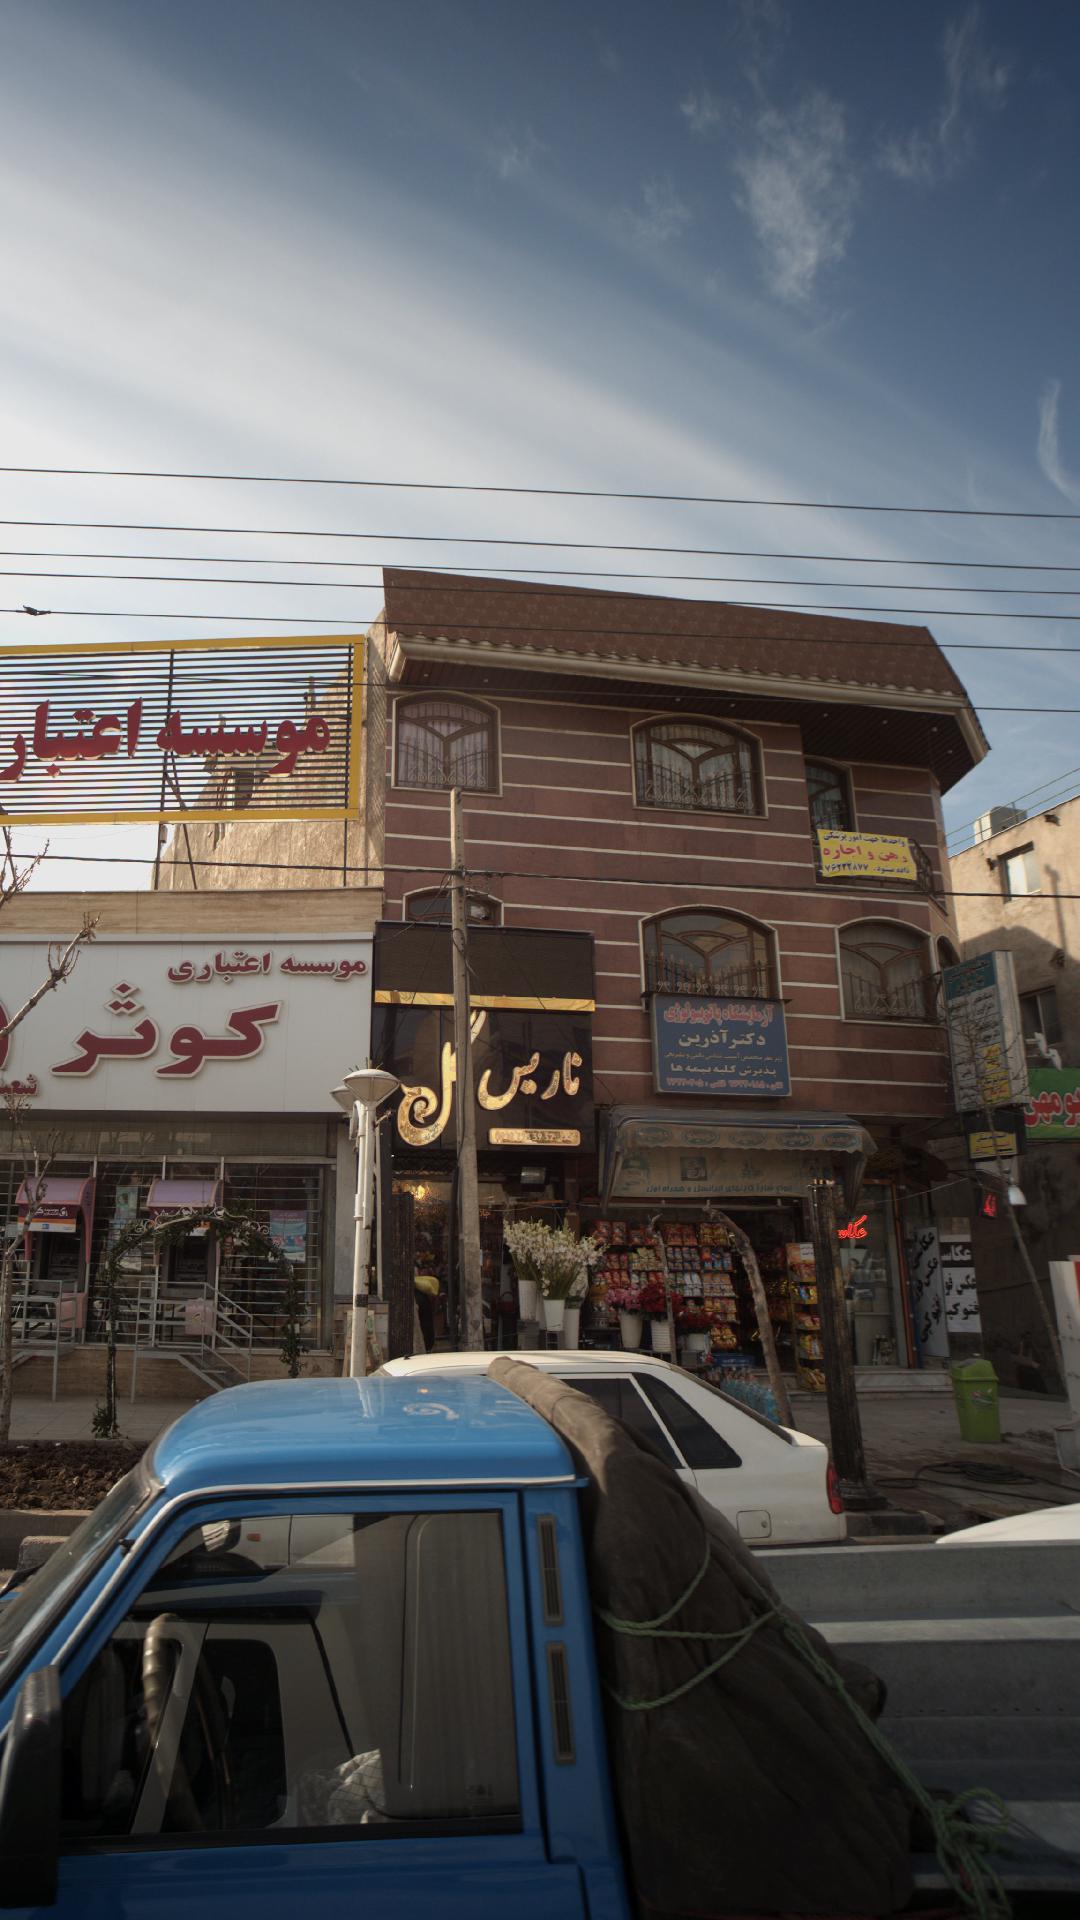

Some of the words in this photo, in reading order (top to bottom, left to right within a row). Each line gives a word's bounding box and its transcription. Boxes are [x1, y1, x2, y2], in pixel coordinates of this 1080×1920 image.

[156, 710, 331, 778] موسسه
[823, 844, 863, 860] اجاره
[868, 851, 875, 861] و
[167, 952, 273, 985] اعتباری
[280, 953, 369, 983] موسسه
[721, 1003, 774, 1027] آزمایشگاه
[51, 981, 282, 1078] کوثر
[678, 1029, 728, 1048] آذرین
[728, 1031, 766, 1049] دکتر
[670, 1061, 683, 1073] ها
[685, 1065, 712, 1076] بیمه
[712, 1063, 737, 1074] کلیه
[739, 1065, 777, 1078] پذیرش
[940, 1244, 972, 1261] عکاس
